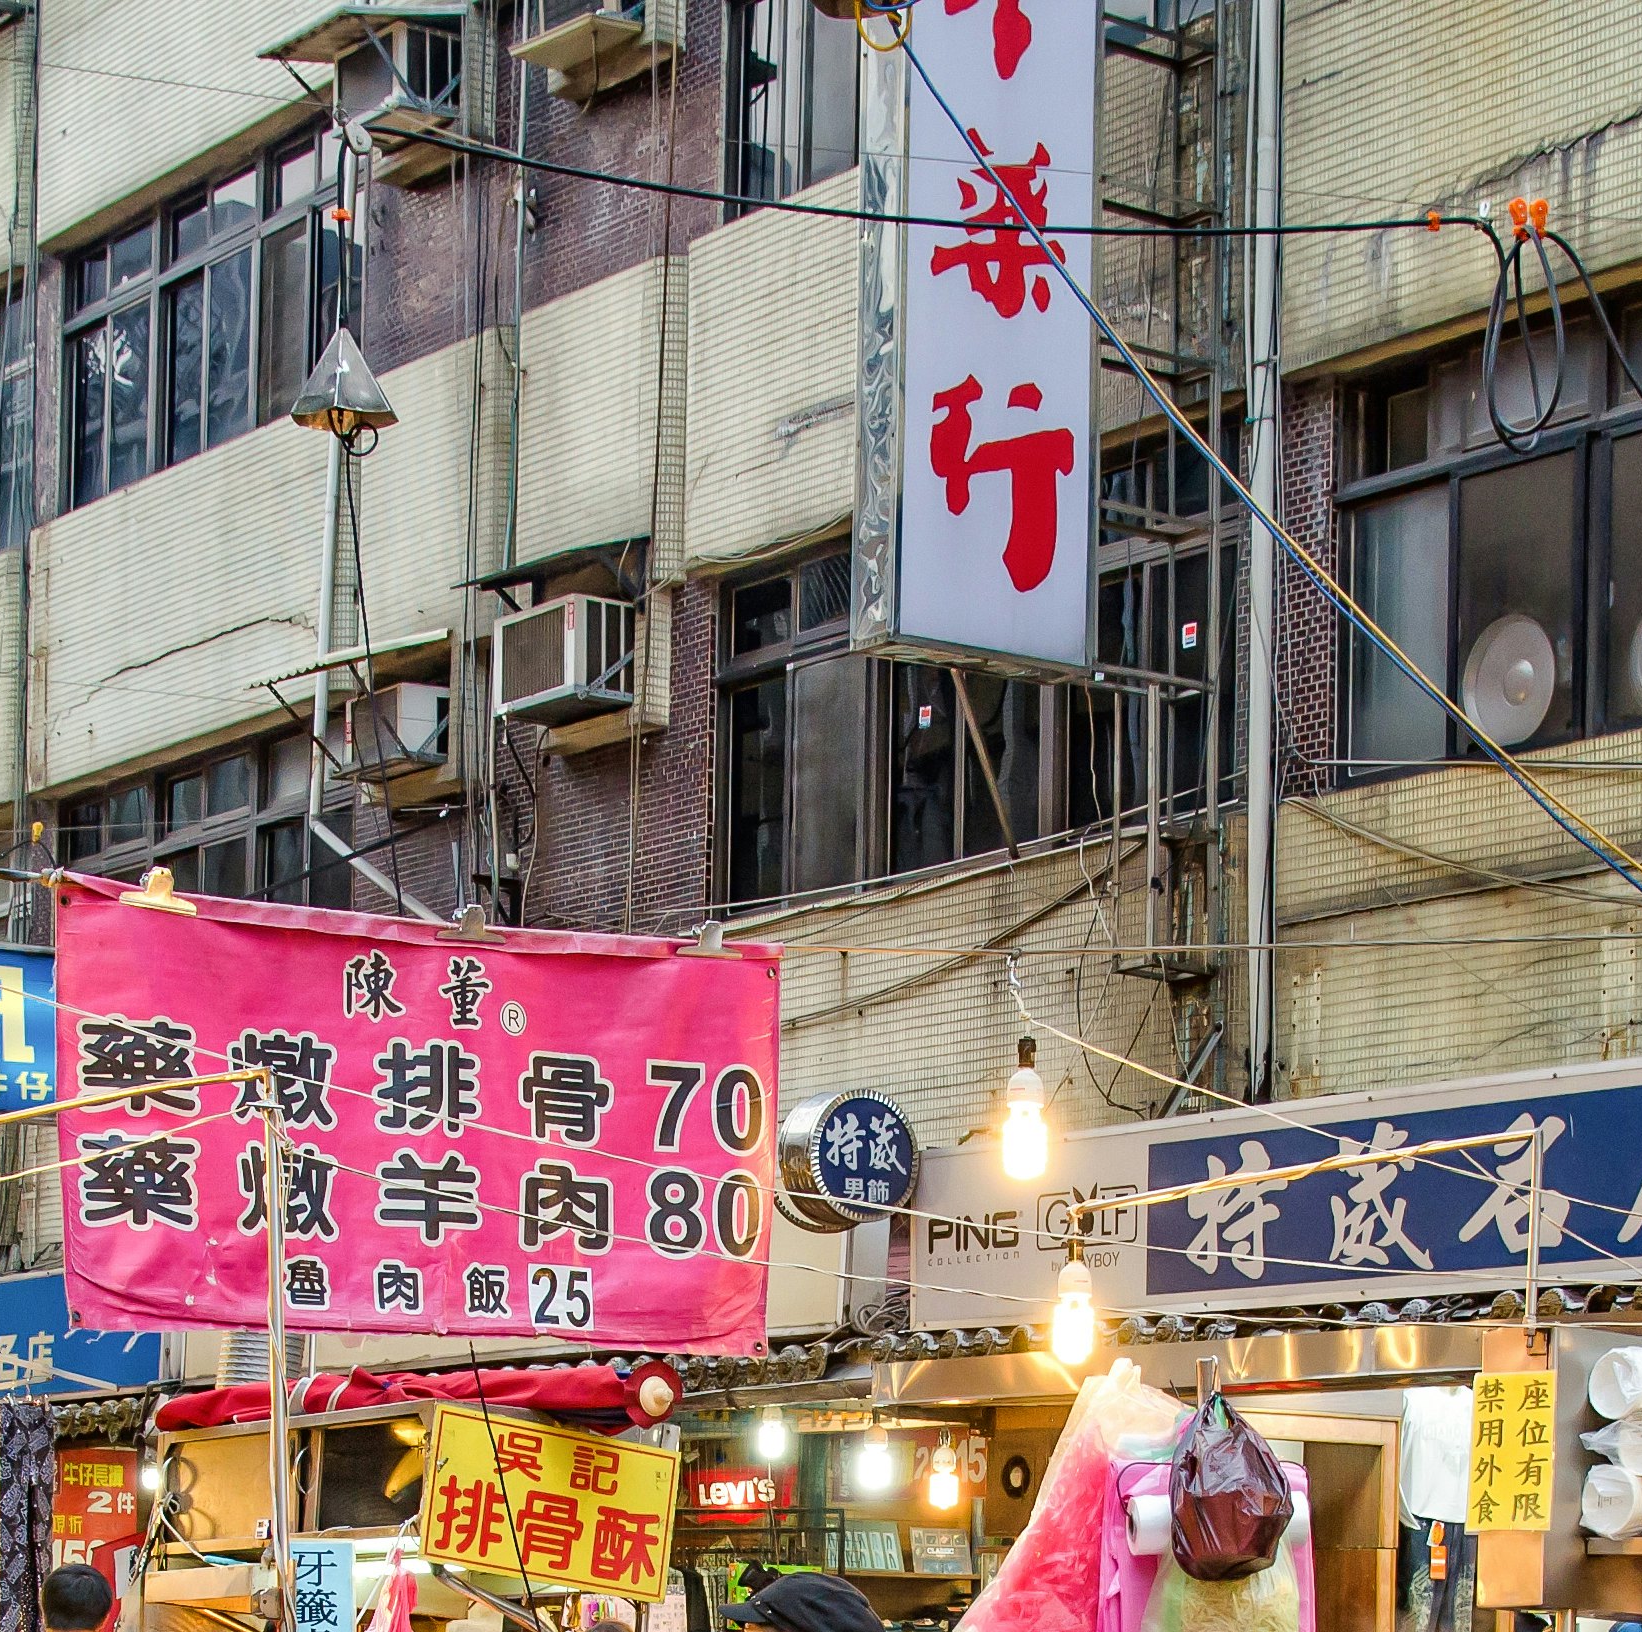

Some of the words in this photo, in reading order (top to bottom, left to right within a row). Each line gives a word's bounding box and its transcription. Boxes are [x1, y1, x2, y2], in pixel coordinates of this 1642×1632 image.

[343, 951, 494, 1029] 陳董
[79, 1016, 611, 1147] 藥燉排骨
[648, 1062, 762, 1157] 70
[81, 1132, 612, 1256] 藥燉羊肉
[646, 1167, 760, 1259] 80
[844, 1177, 889, 1203] 男飾
[928, 1210, 1019, 1254] PING
[928, 1250, 1020, 1267] COLLECTION
[286, 1258, 507, 1317] 魯肉飯
[531, 1267, 591, 1326] 25
[63, 1463, 124, 1487] 牛仔長褲
[496, 1432, 621, 1497] 吳記
[1472, 1380, 1505, 1523] 禁用外食
[1511, 1380, 1554, 1520] 座位有限
[432, 1475, 660, 1586] 排骨酥
